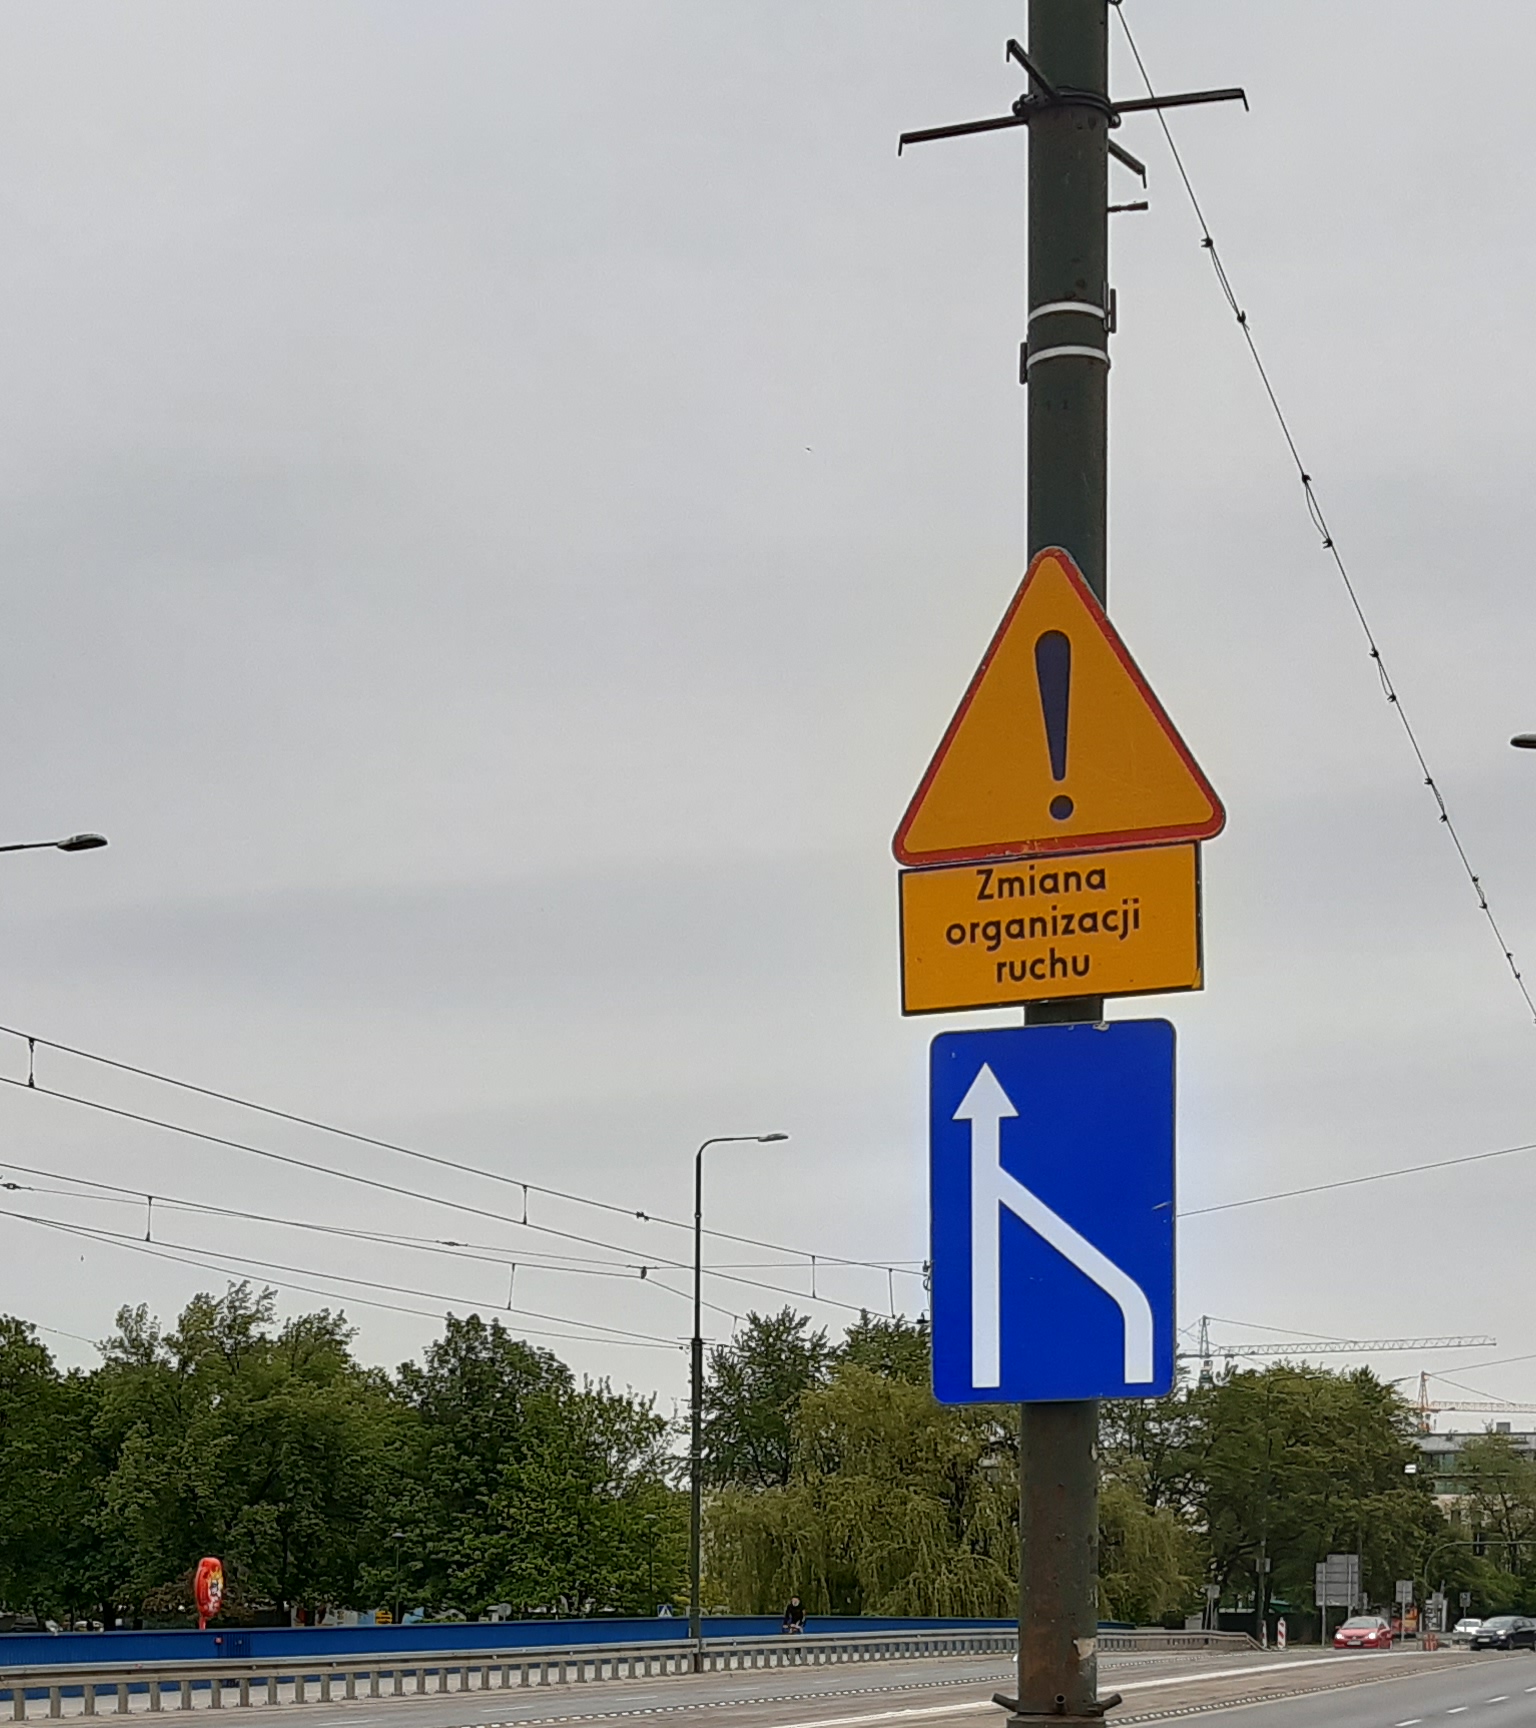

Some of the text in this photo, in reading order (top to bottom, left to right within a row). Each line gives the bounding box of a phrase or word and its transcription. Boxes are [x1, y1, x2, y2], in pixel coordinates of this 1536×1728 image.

[976, 864, 1107, 901] Zmiana
[946, 898, 1140, 951] organizacji
[996, 948, 1090, 983] ruchu
